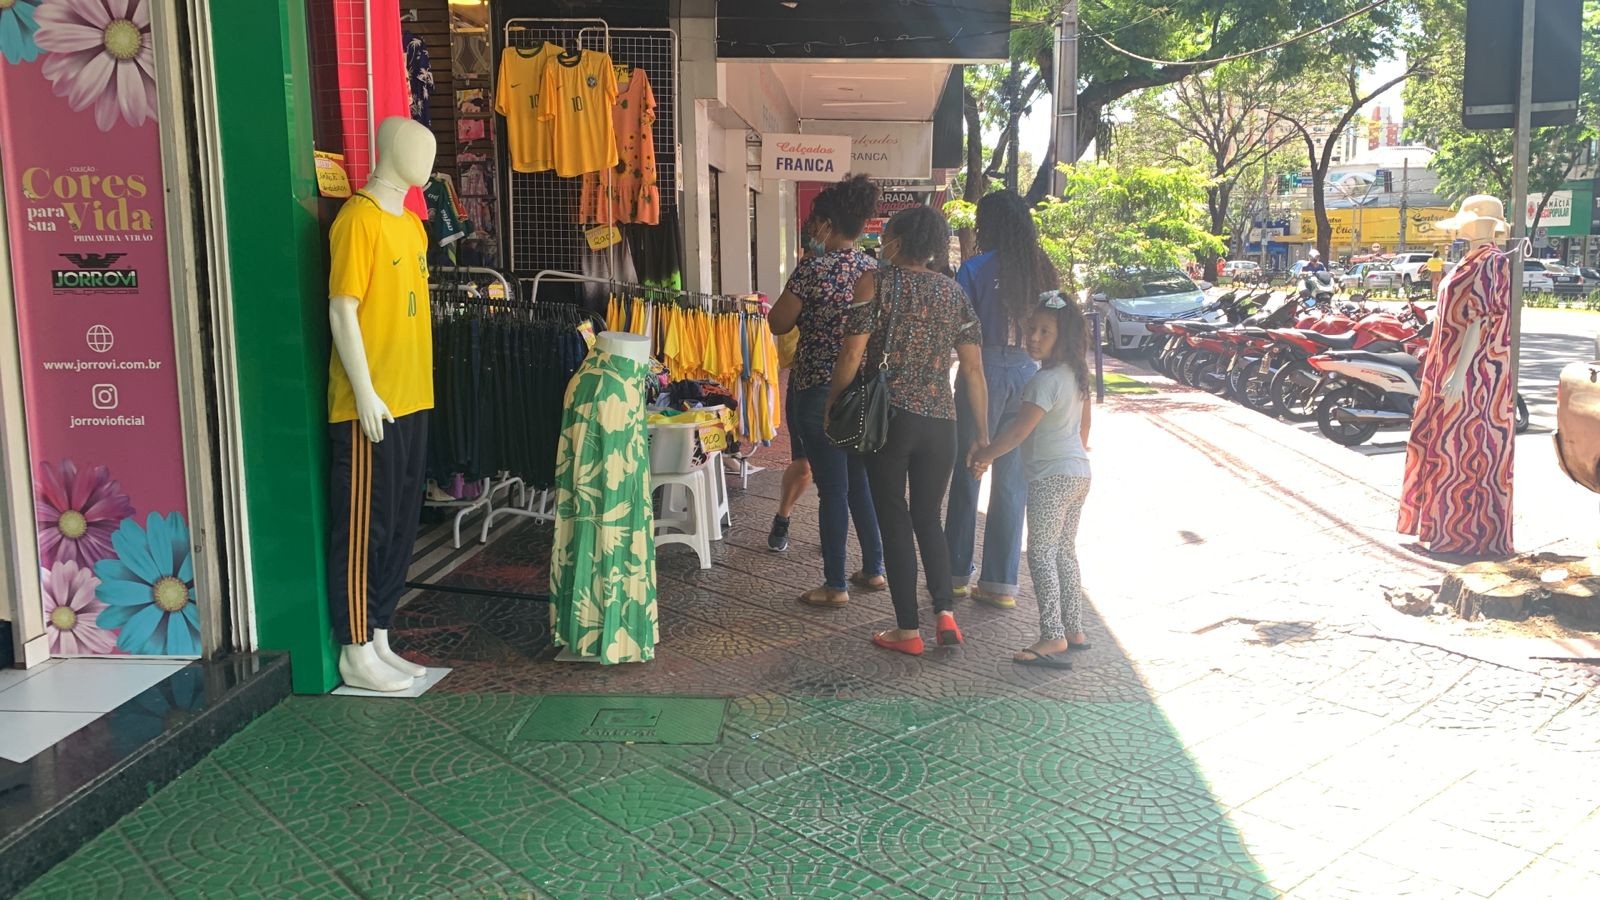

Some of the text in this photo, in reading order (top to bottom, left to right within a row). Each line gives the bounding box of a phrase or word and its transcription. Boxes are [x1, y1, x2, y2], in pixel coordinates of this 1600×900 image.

[571, 96, 583, 112] 10
[851, 133, 899, 148] alçados
[776, 142, 834, 155] Calçados
[850, 152, 888, 161] RANCA
[776, 157, 834, 173] FRANCA
[22, 167, 147, 200] Cores
[878, 192, 914, 202] ARADA
[1537, 199, 1570, 208] FMÁCIA
[27, 207, 65, 222] para
[61, 197, 153, 232] Vida
[28, 221, 57, 232] sua
[73, 233, 153, 242] PRIMAVERA VERÃO
[55, 270, 137, 287] JORROVI
[43, 359, 161, 372] www.jorrovi.com.br
[69, 415, 145, 428] jorrovioficial
